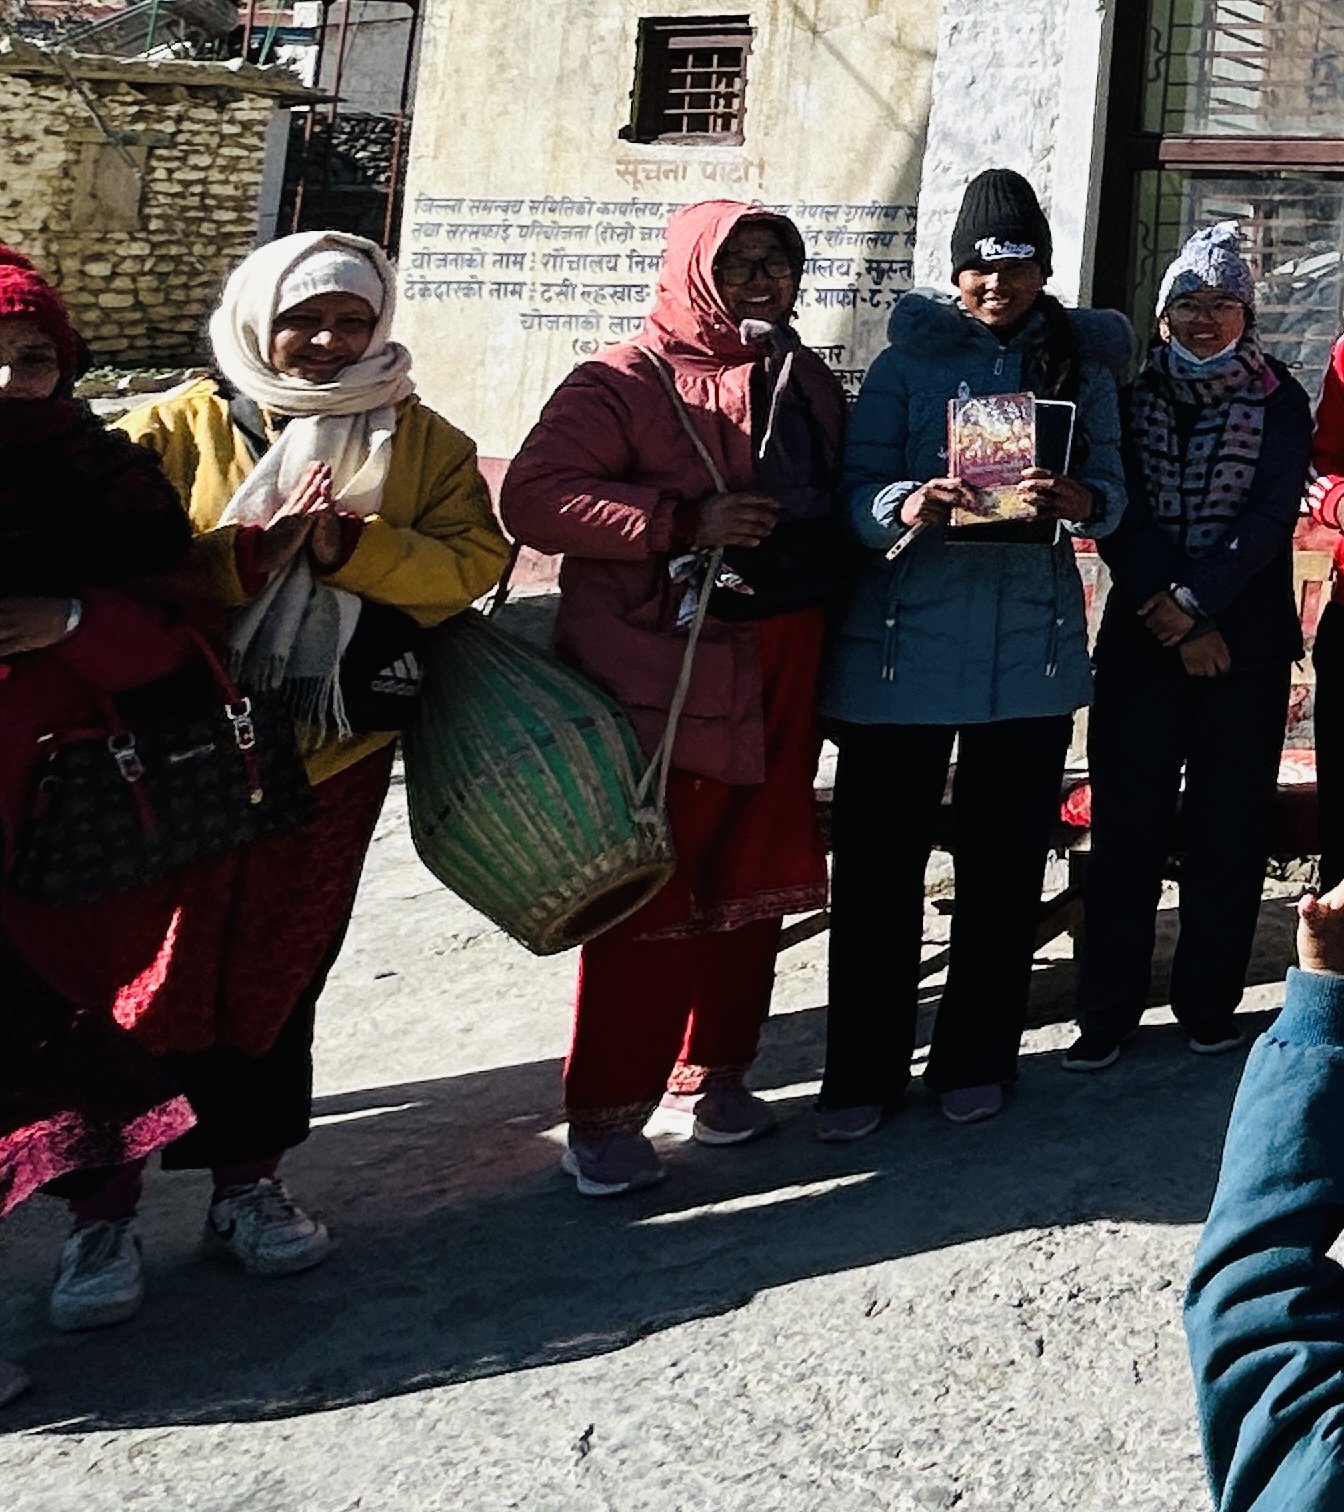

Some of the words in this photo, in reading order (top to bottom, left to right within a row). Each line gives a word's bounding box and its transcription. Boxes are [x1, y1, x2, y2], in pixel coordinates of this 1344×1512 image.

[615, 158, 689, 190] सूचना
[411, 247, 488, 270] योजनाको
[491, 252, 527, 272] नाम
[540, 247, 621, 273] शौचालय
[488, 280, 528, 301] नाम
[520, 309, 603, 332] योजनाको
